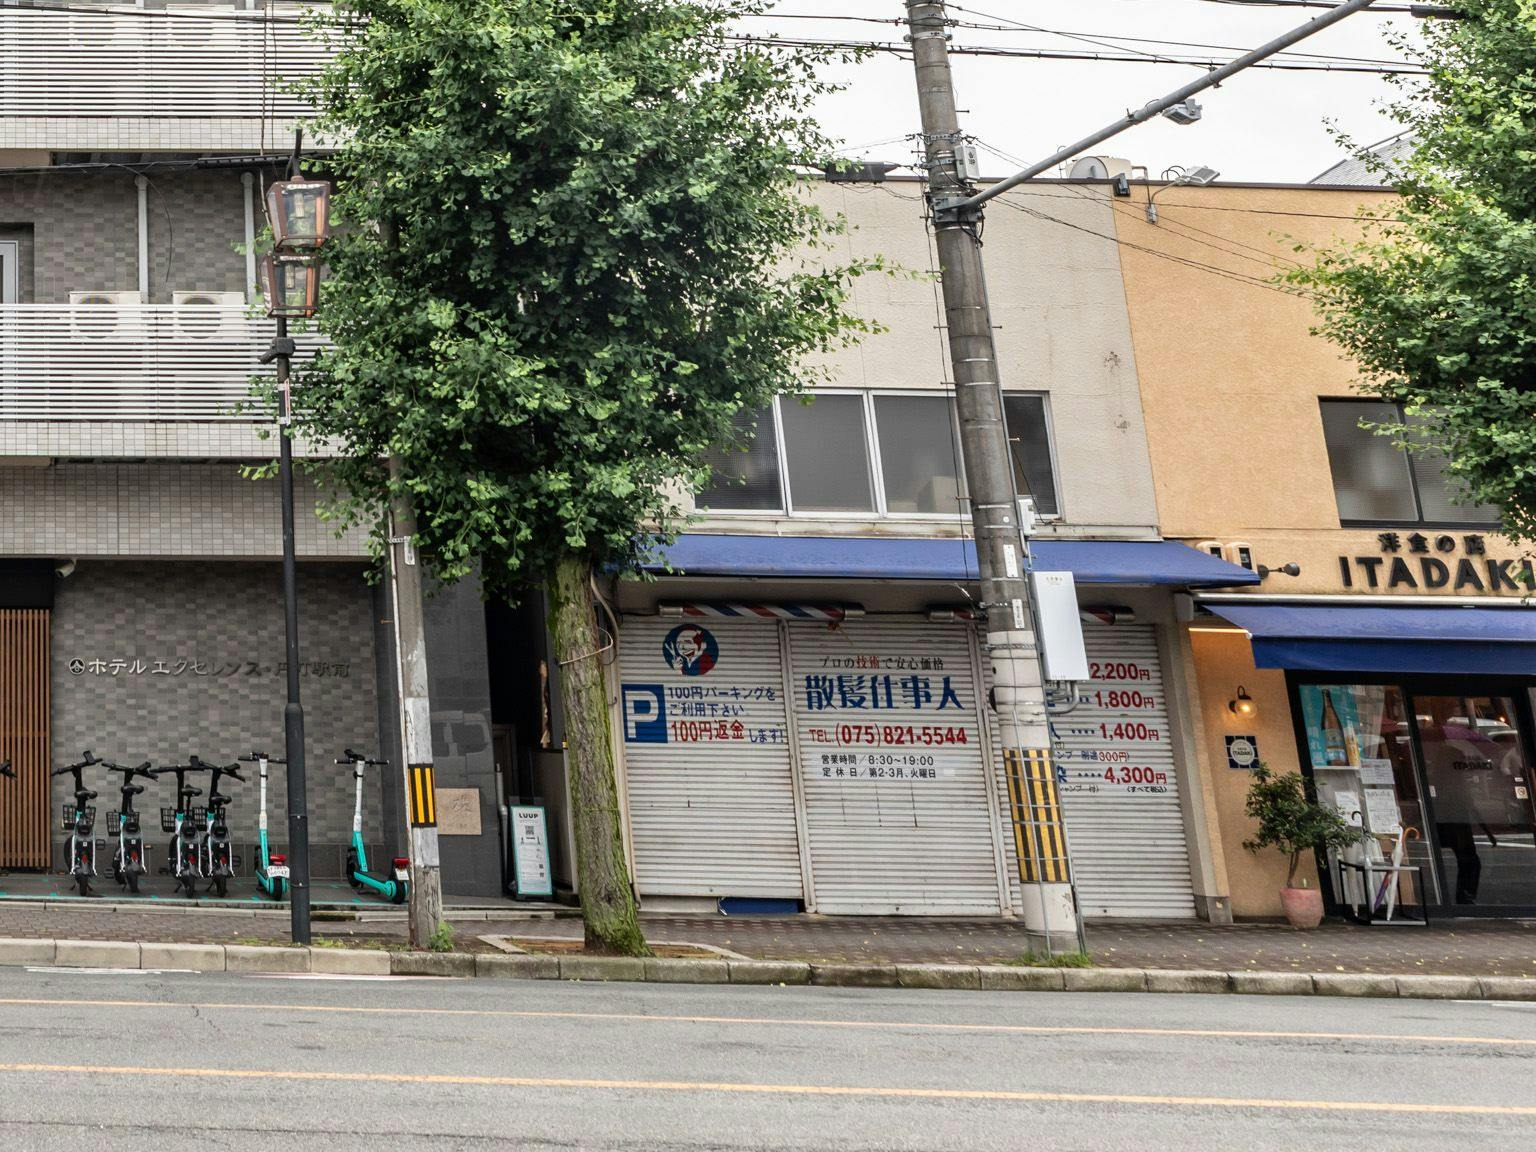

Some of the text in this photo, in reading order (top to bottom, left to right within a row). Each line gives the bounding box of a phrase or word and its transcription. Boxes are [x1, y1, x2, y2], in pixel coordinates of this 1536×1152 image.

[1338, 556, 1536, 591] ITADAKI
[88, 658, 147, 676] ホテル
[818, 656, 944, 670] プロの技術で安心価格
[1089, 662, 1150, 681] 2,200円
[667, 686, 777, 701] 100円パーキングを
[804, 674, 966, 711] 散髪仕事人
[1095, 691, 1155, 709] 1,800円
[624, 690, 659, 739] P
[669, 703, 745, 717] ご利用下さい
[670, 719, 745, 742] 100円返金
[1100, 723, 1160, 741] 1,400円
[1104, 766, 1167, 785] 4,300円
